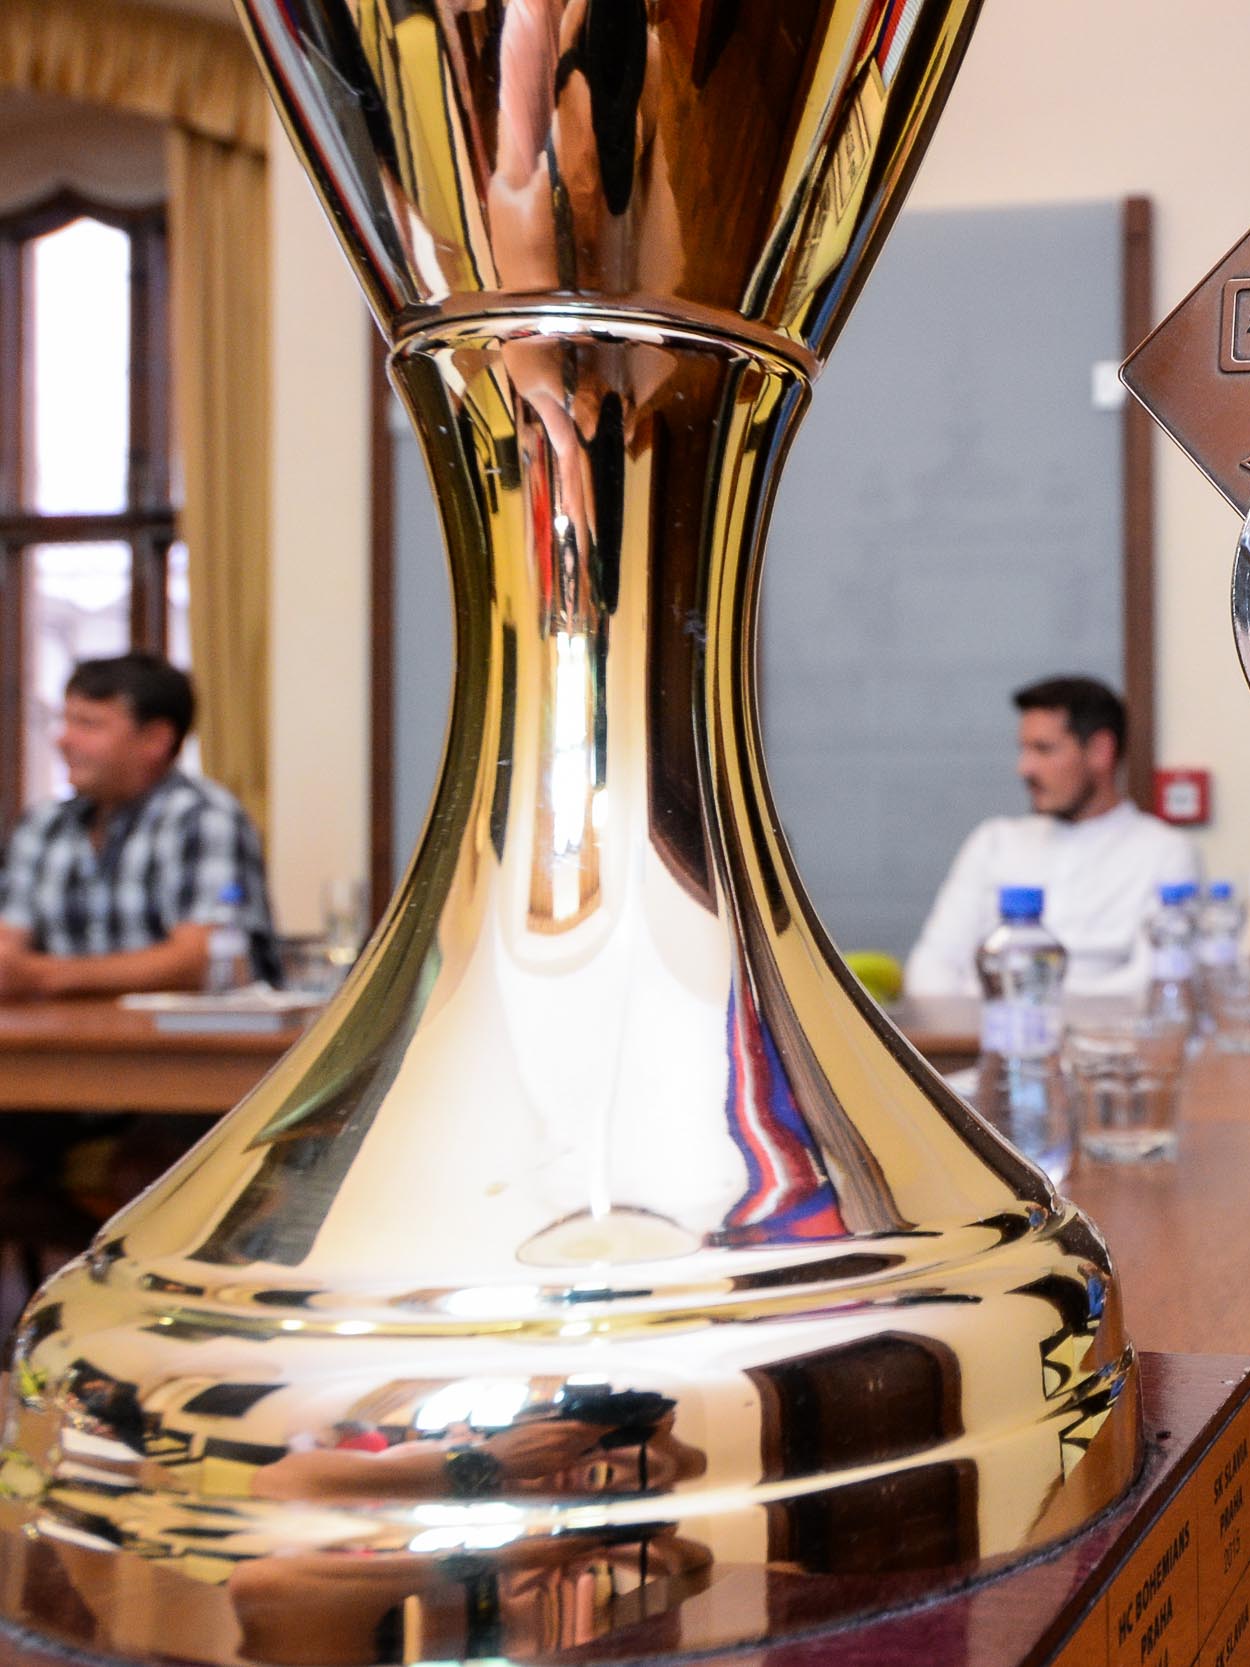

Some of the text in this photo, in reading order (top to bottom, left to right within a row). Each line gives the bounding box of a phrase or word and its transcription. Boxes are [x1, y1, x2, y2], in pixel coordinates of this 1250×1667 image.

[1119, 1520, 1190, 1648] HC BOHEMIANS
[1141, 1594, 1173, 1664] PRAHA
